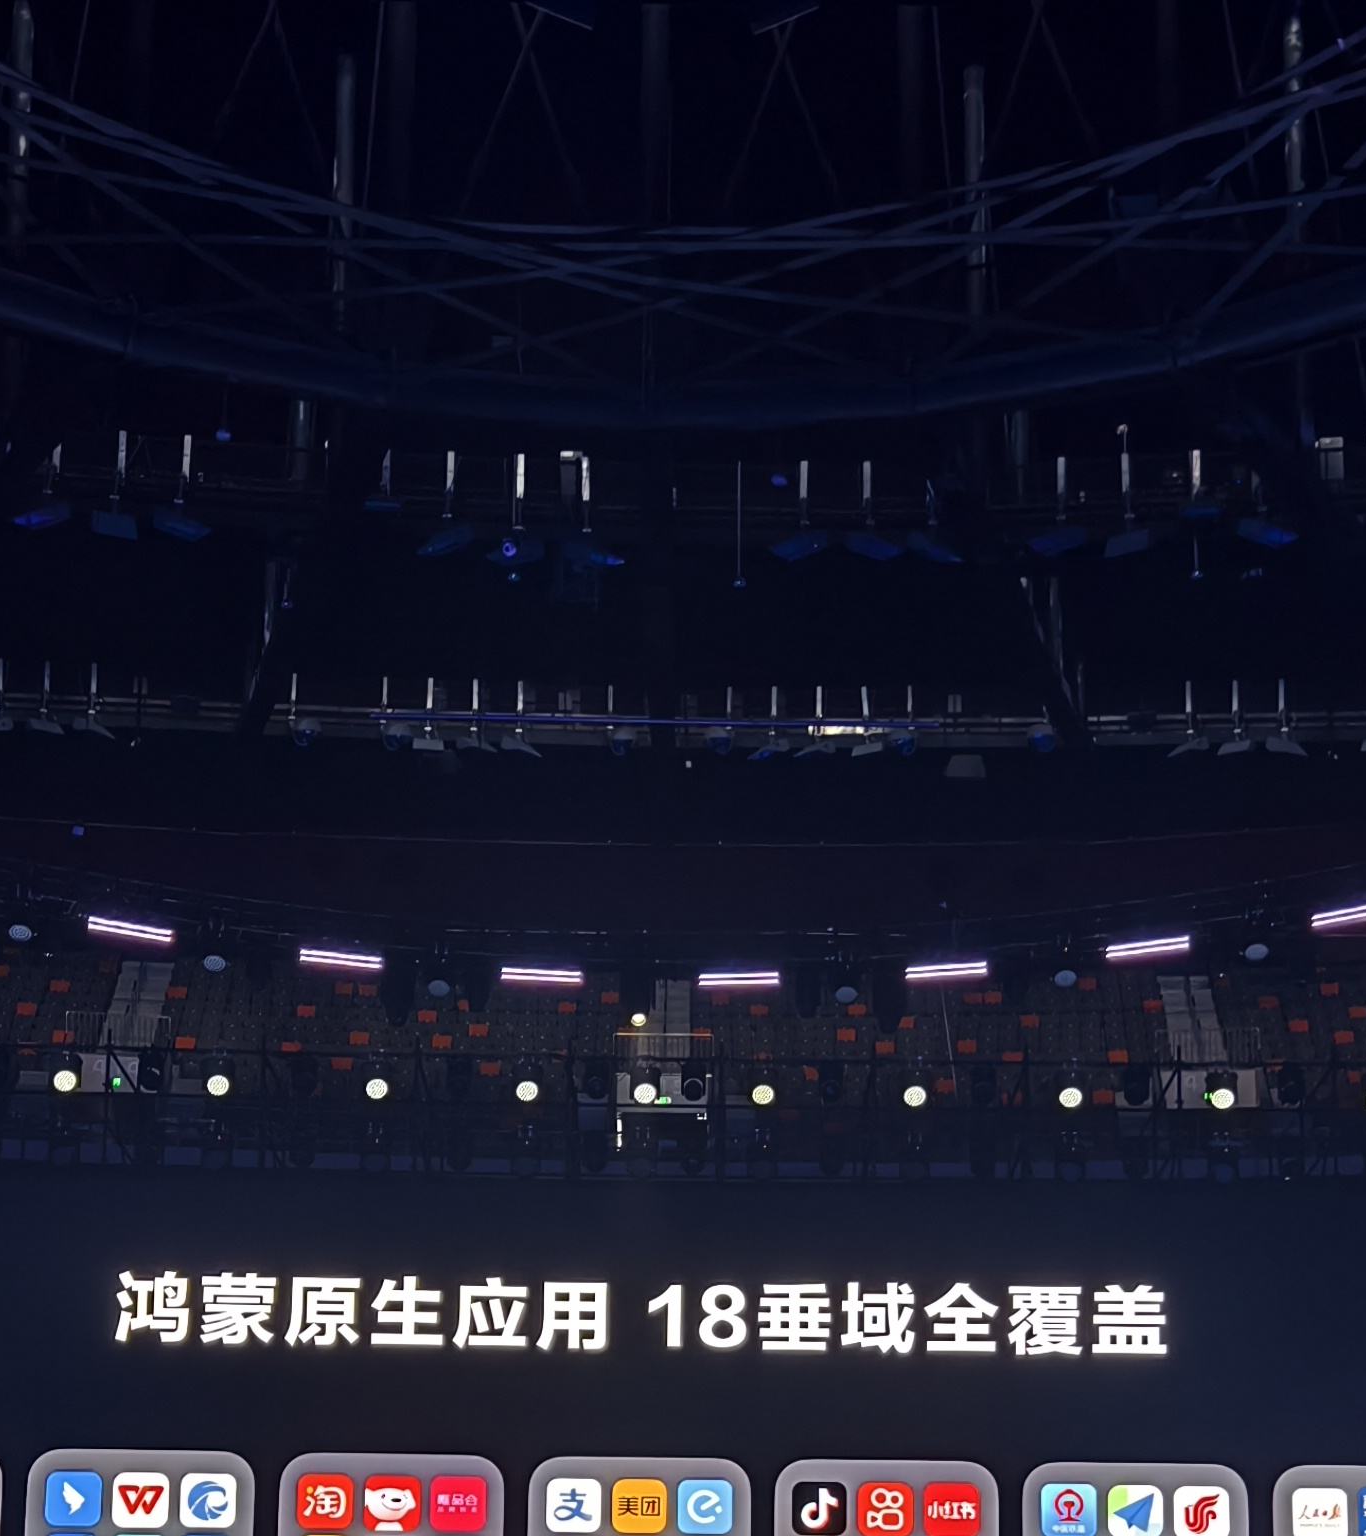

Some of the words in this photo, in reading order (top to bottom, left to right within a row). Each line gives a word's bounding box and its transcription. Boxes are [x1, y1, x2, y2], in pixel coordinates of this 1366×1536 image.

[114, 1270, 612, 1350] 鸿蒙原生应用
[646, 1281, 1168, 1356] 18垂域全覆盖
[303, 1484, 347, 1518] 淘
[437, 1493, 478, 1506] 唯品会
[554, 1488, 593, 1522] 支
[618, 1496, 661, 1516] 美团
[927, 1501, 976, 1520] 小红书
